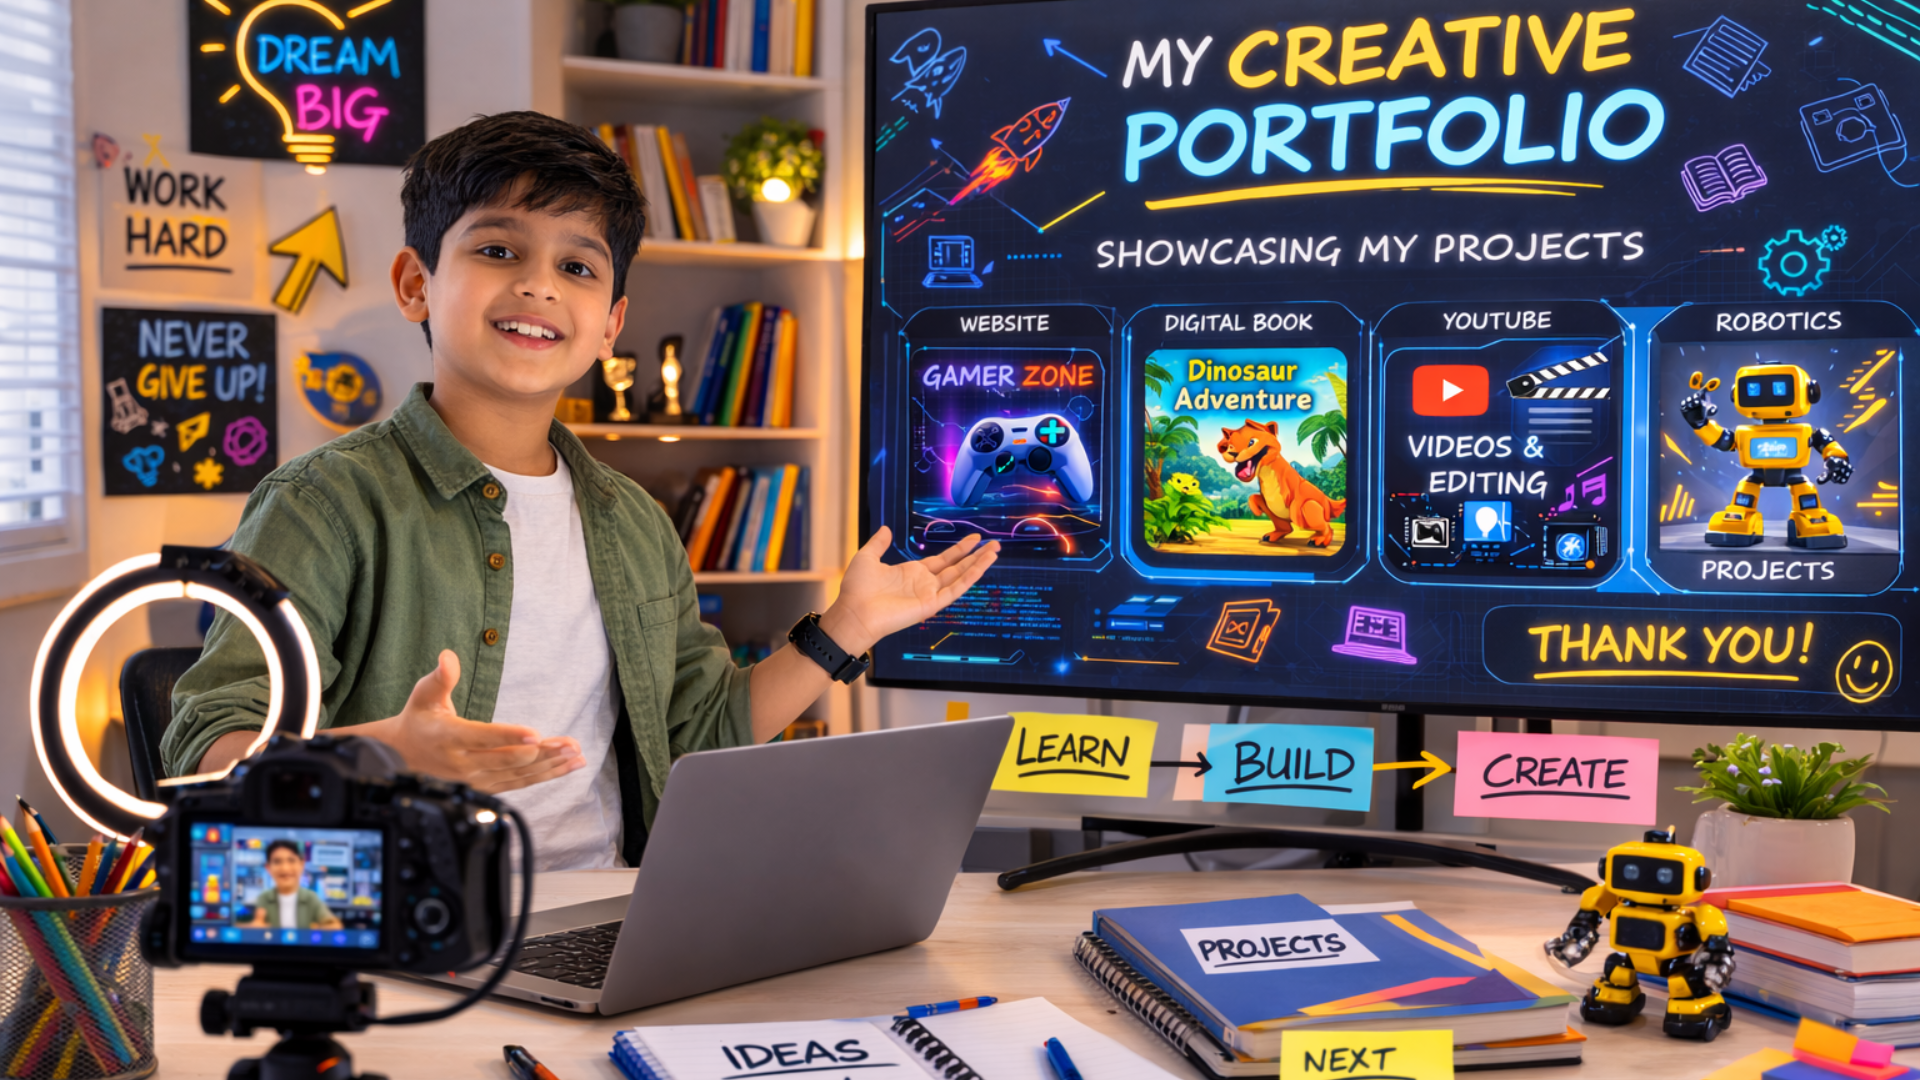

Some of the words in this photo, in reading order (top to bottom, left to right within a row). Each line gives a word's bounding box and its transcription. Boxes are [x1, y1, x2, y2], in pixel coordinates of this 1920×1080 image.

[256, 33, 402, 79] DREAM
[1121, 36, 1213, 90] MY
[1227, 8, 1636, 89] CREATIVE
[296, 83, 390, 143] BIG
[1124, 88, 1666, 182] PORTFOLIO
[124, 166, 228, 211] WORK
[126, 216, 228, 260] HARD
[1096, 235, 1341, 271] SHOWCASING
[1358, 233, 1418, 264] MY
[1434, 231, 1645, 263] PROJECTS
[960, 314, 1050, 333] WEBSITE
[1164, 313, 1246, 333] DIGITAL
[1252, 313, 1313, 332] BOOK
[1443, 310, 1553, 331] YOUTUBE
[1716, 311, 1842, 333] ROBOTICS
[138, 320, 250, 360] NEVER
[136, 364, 207, 400] GIVE
[214, 363, 267, 404] UP!
[922, 364, 1015, 388] GAMER
[1022, 364, 1094, 386] ZONE
[1188, 359, 1298, 383] Dinosaur
[1174, 386, 1312, 411] Adventure
[1408, 435, 1512, 459] VIDEOS
[1523, 435, 1544, 459] &
[1429, 470, 1548, 499] EDITING
[1701, 560, 1835, 581] PROJECTS
[1528, 624, 1687, 664] THANK
[1703, 622, 1815, 665] YOU!
[1017, 727, 1131, 768] LEARN
[1234, 741, 1355, 784] BUILD
[1482, 753, 1628, 790] CREATE
[1198, 932, 1347, 961] PROJECTS
[722, 1039, 869, 1071] IDEAS
[1304, 1047, 1396, 1072] NEXT
